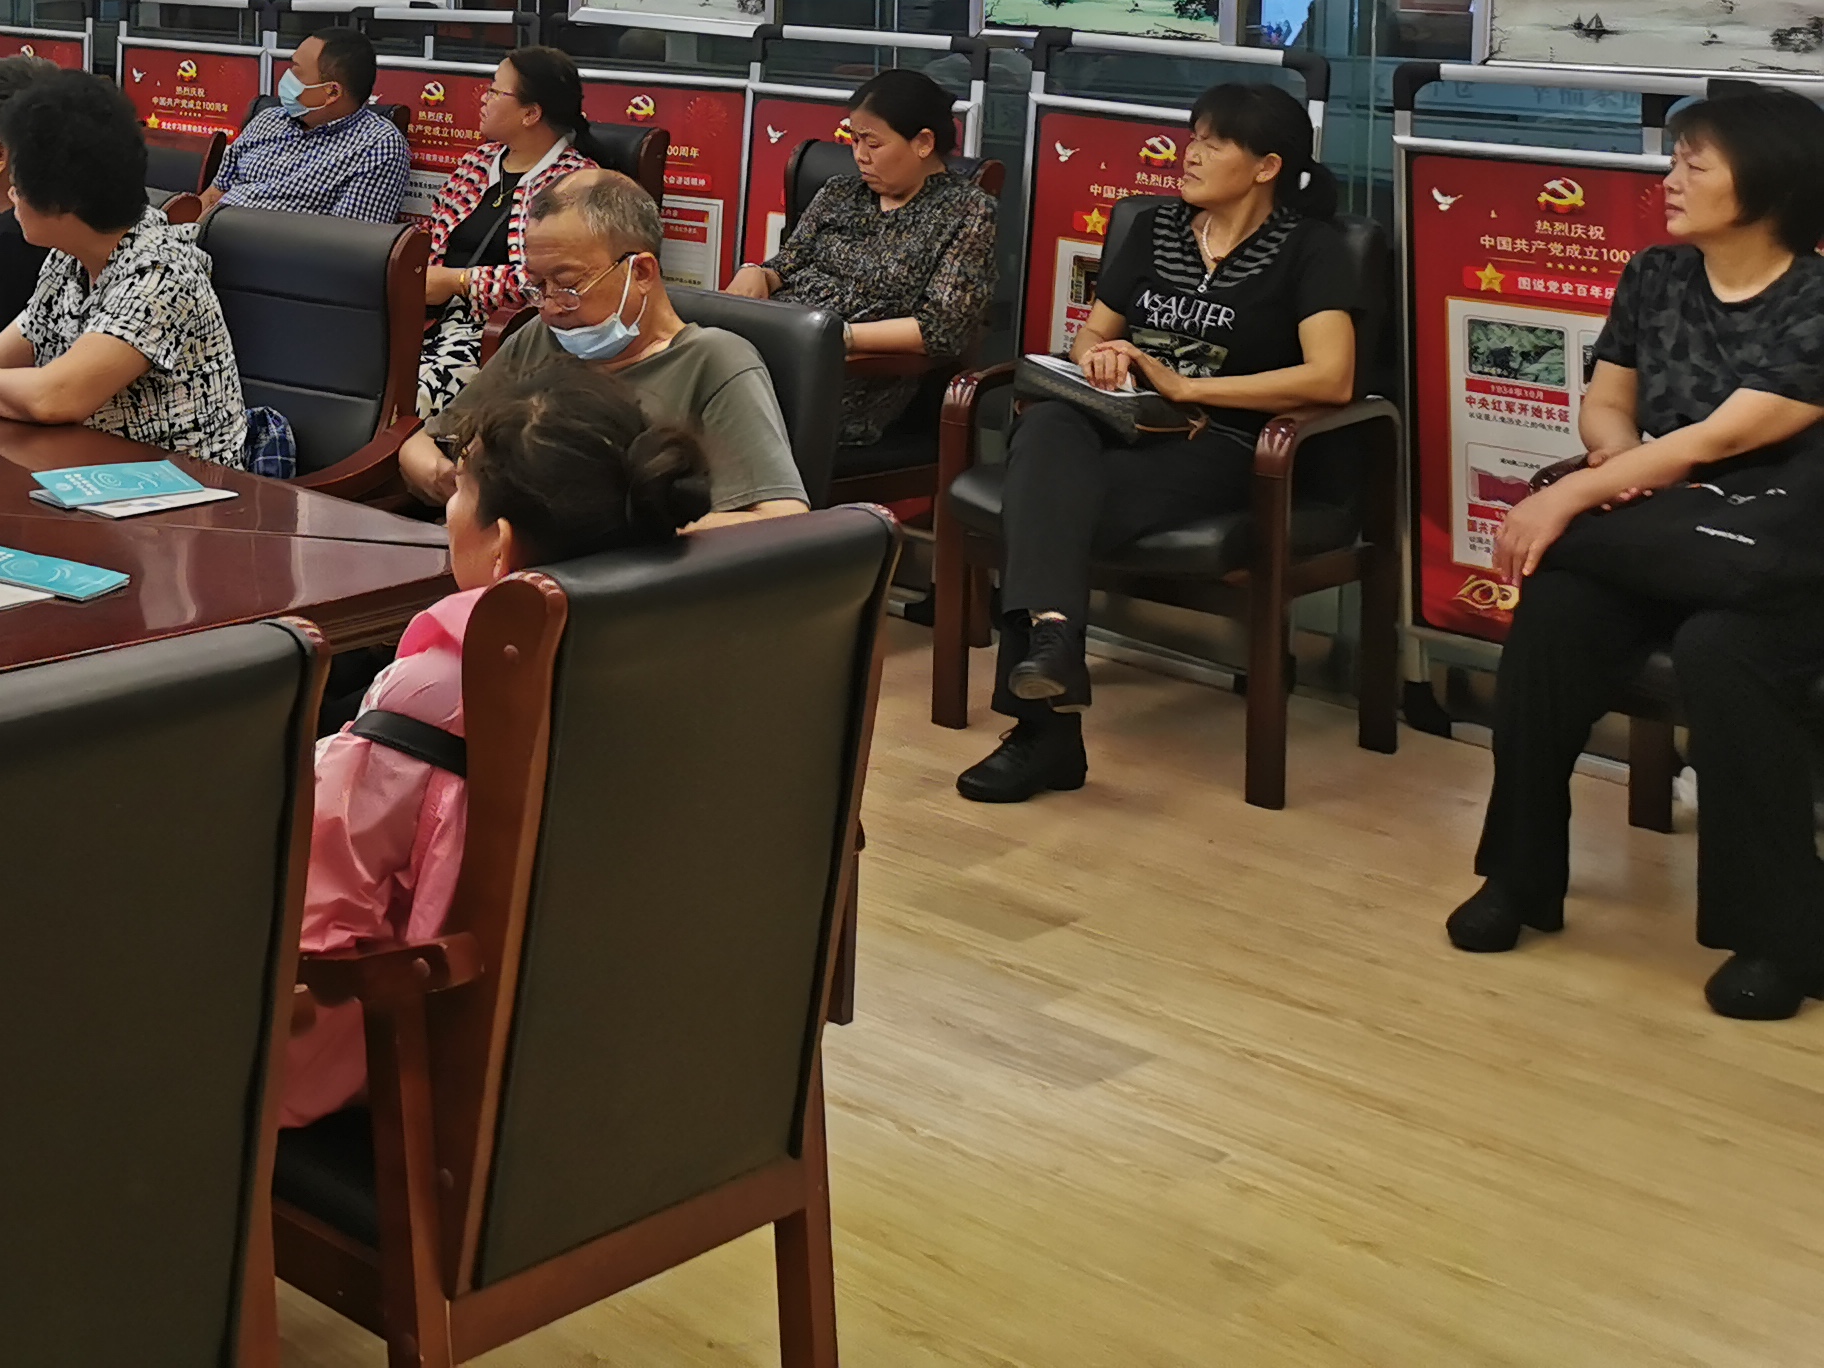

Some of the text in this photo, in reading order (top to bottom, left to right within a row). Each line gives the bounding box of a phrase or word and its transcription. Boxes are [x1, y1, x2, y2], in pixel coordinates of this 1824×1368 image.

[1535, 220, 1606, 241] 热烈庆祝
[1480, 234, 1636, 263] 中国共产党成立100
[1465, 395, 1570, 423] 中央红军开始长征
